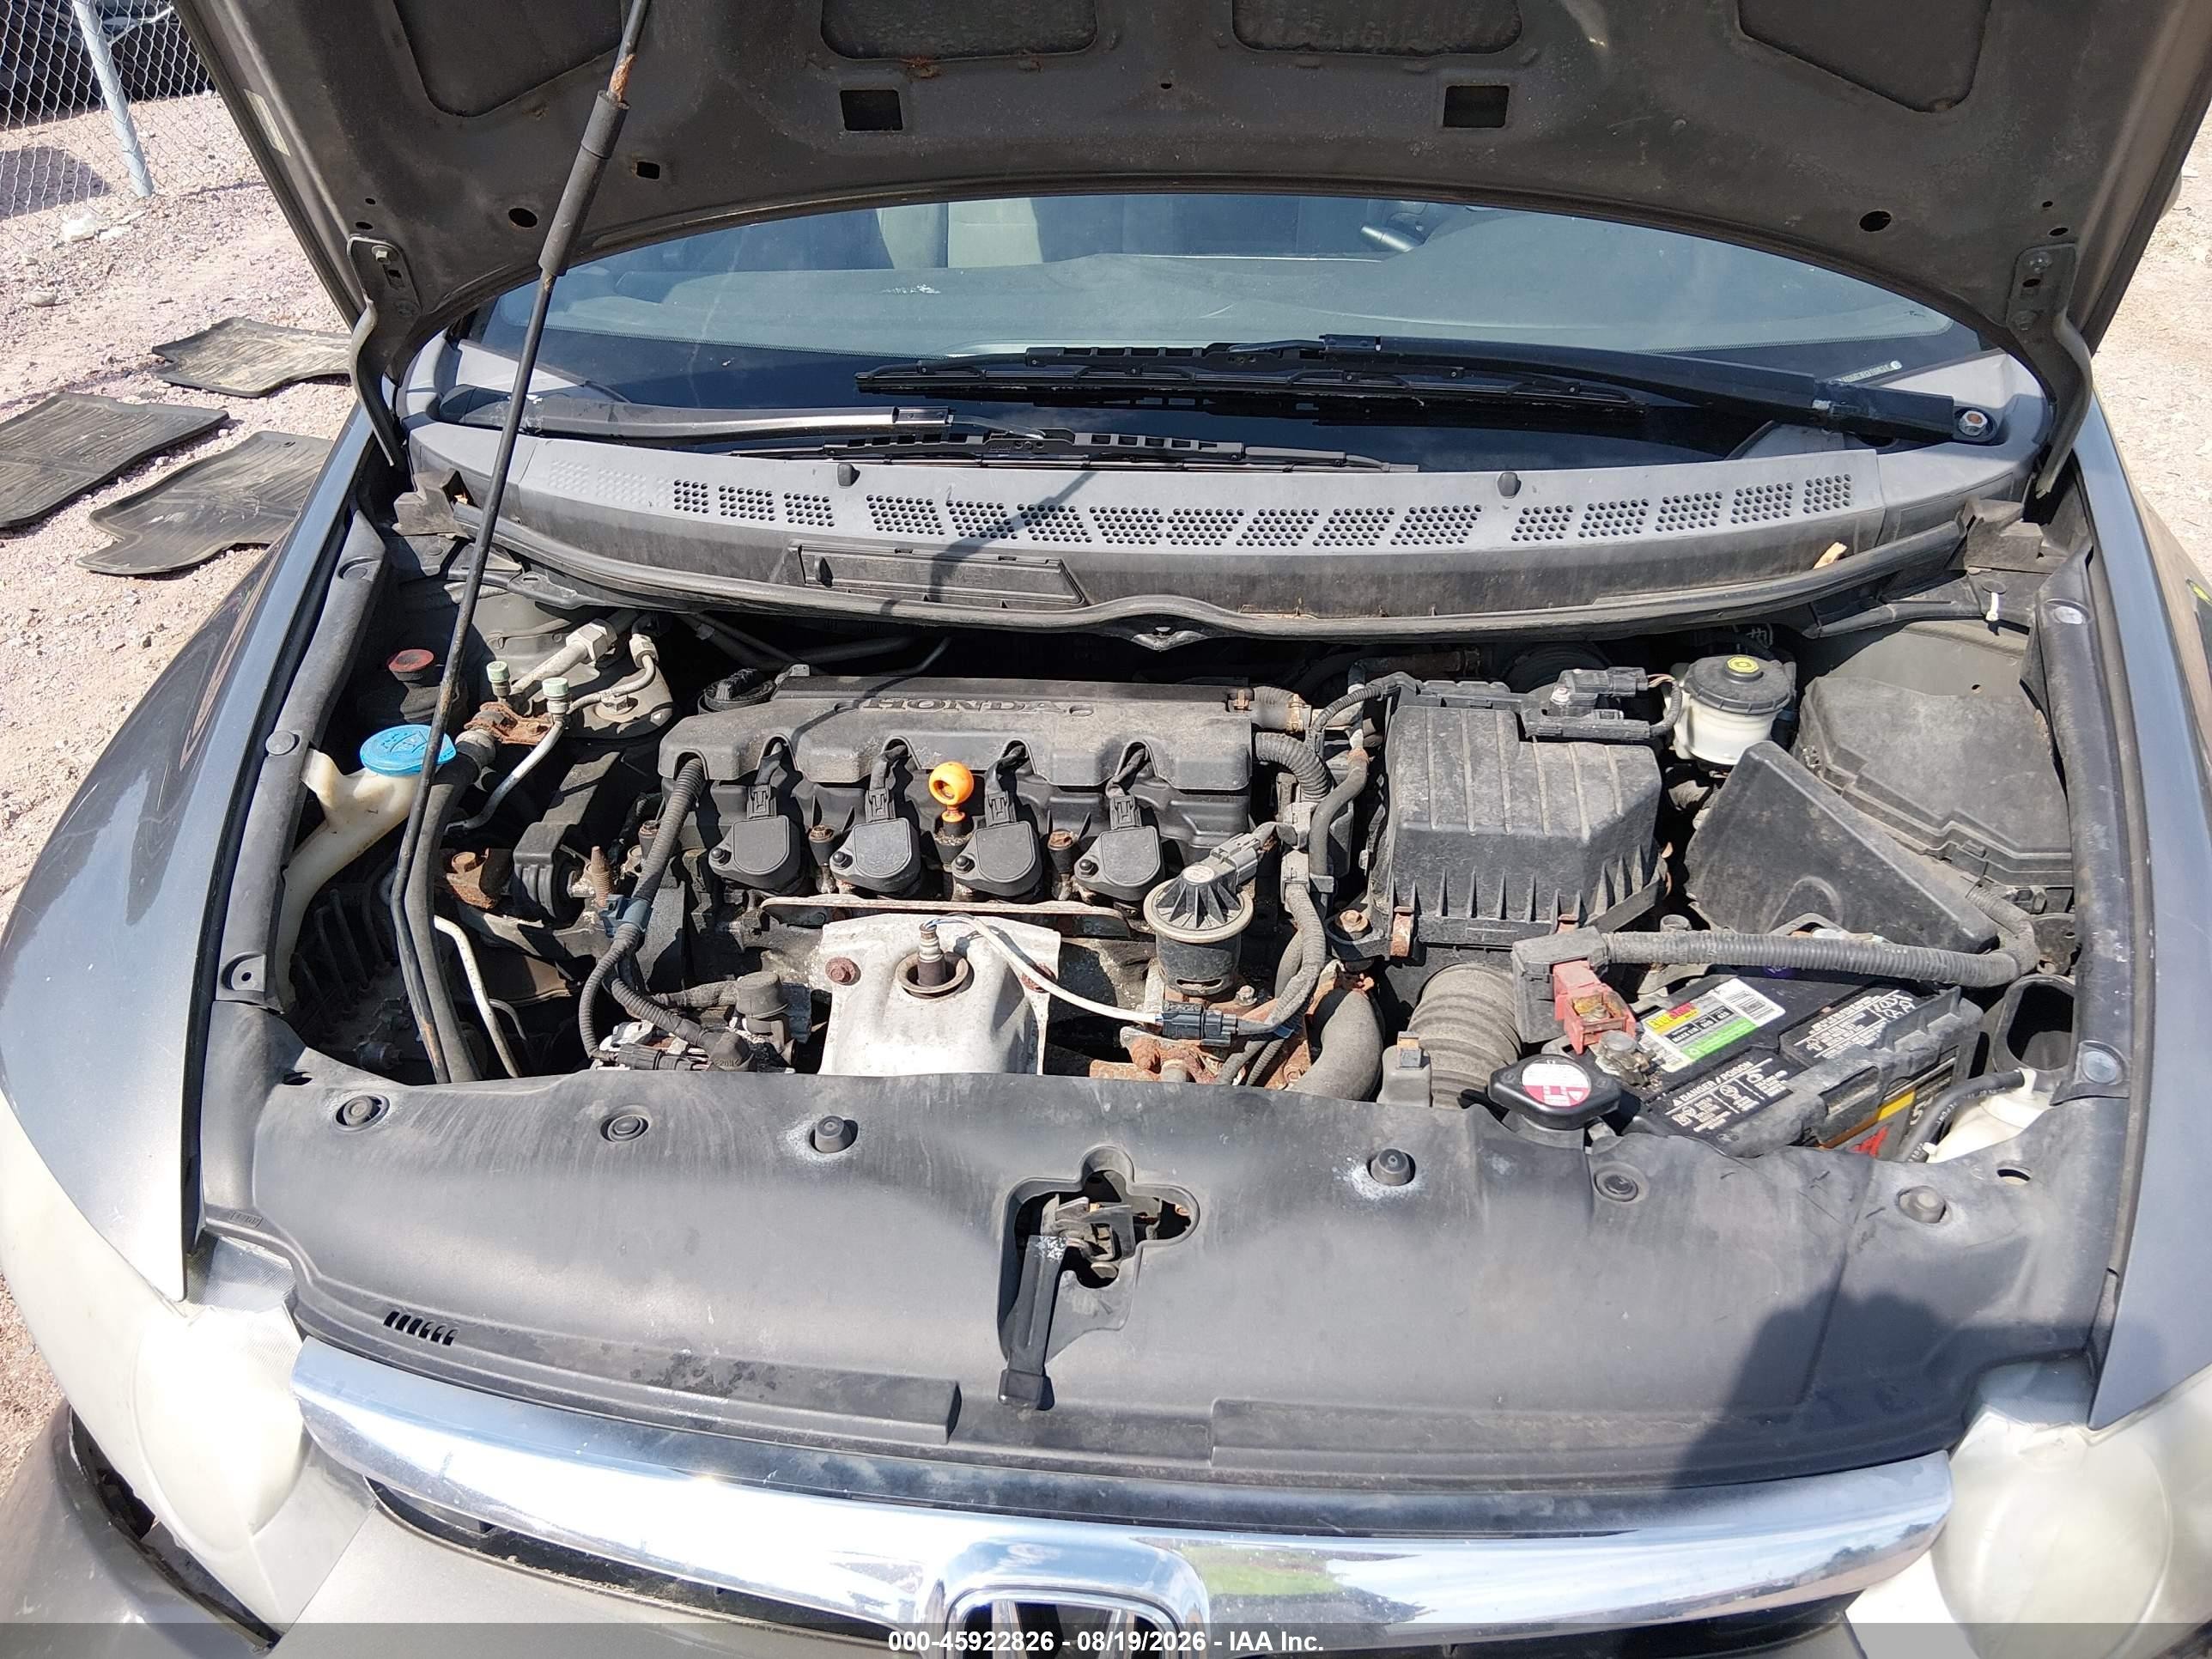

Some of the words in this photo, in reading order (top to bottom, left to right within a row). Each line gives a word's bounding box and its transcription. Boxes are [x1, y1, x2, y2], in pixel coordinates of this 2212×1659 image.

[863, 696, 1067, 714] HONDA
[1680, 1080, 1717, 1102] DANGER
[1720, 1060, 1753, 1080] POISON
